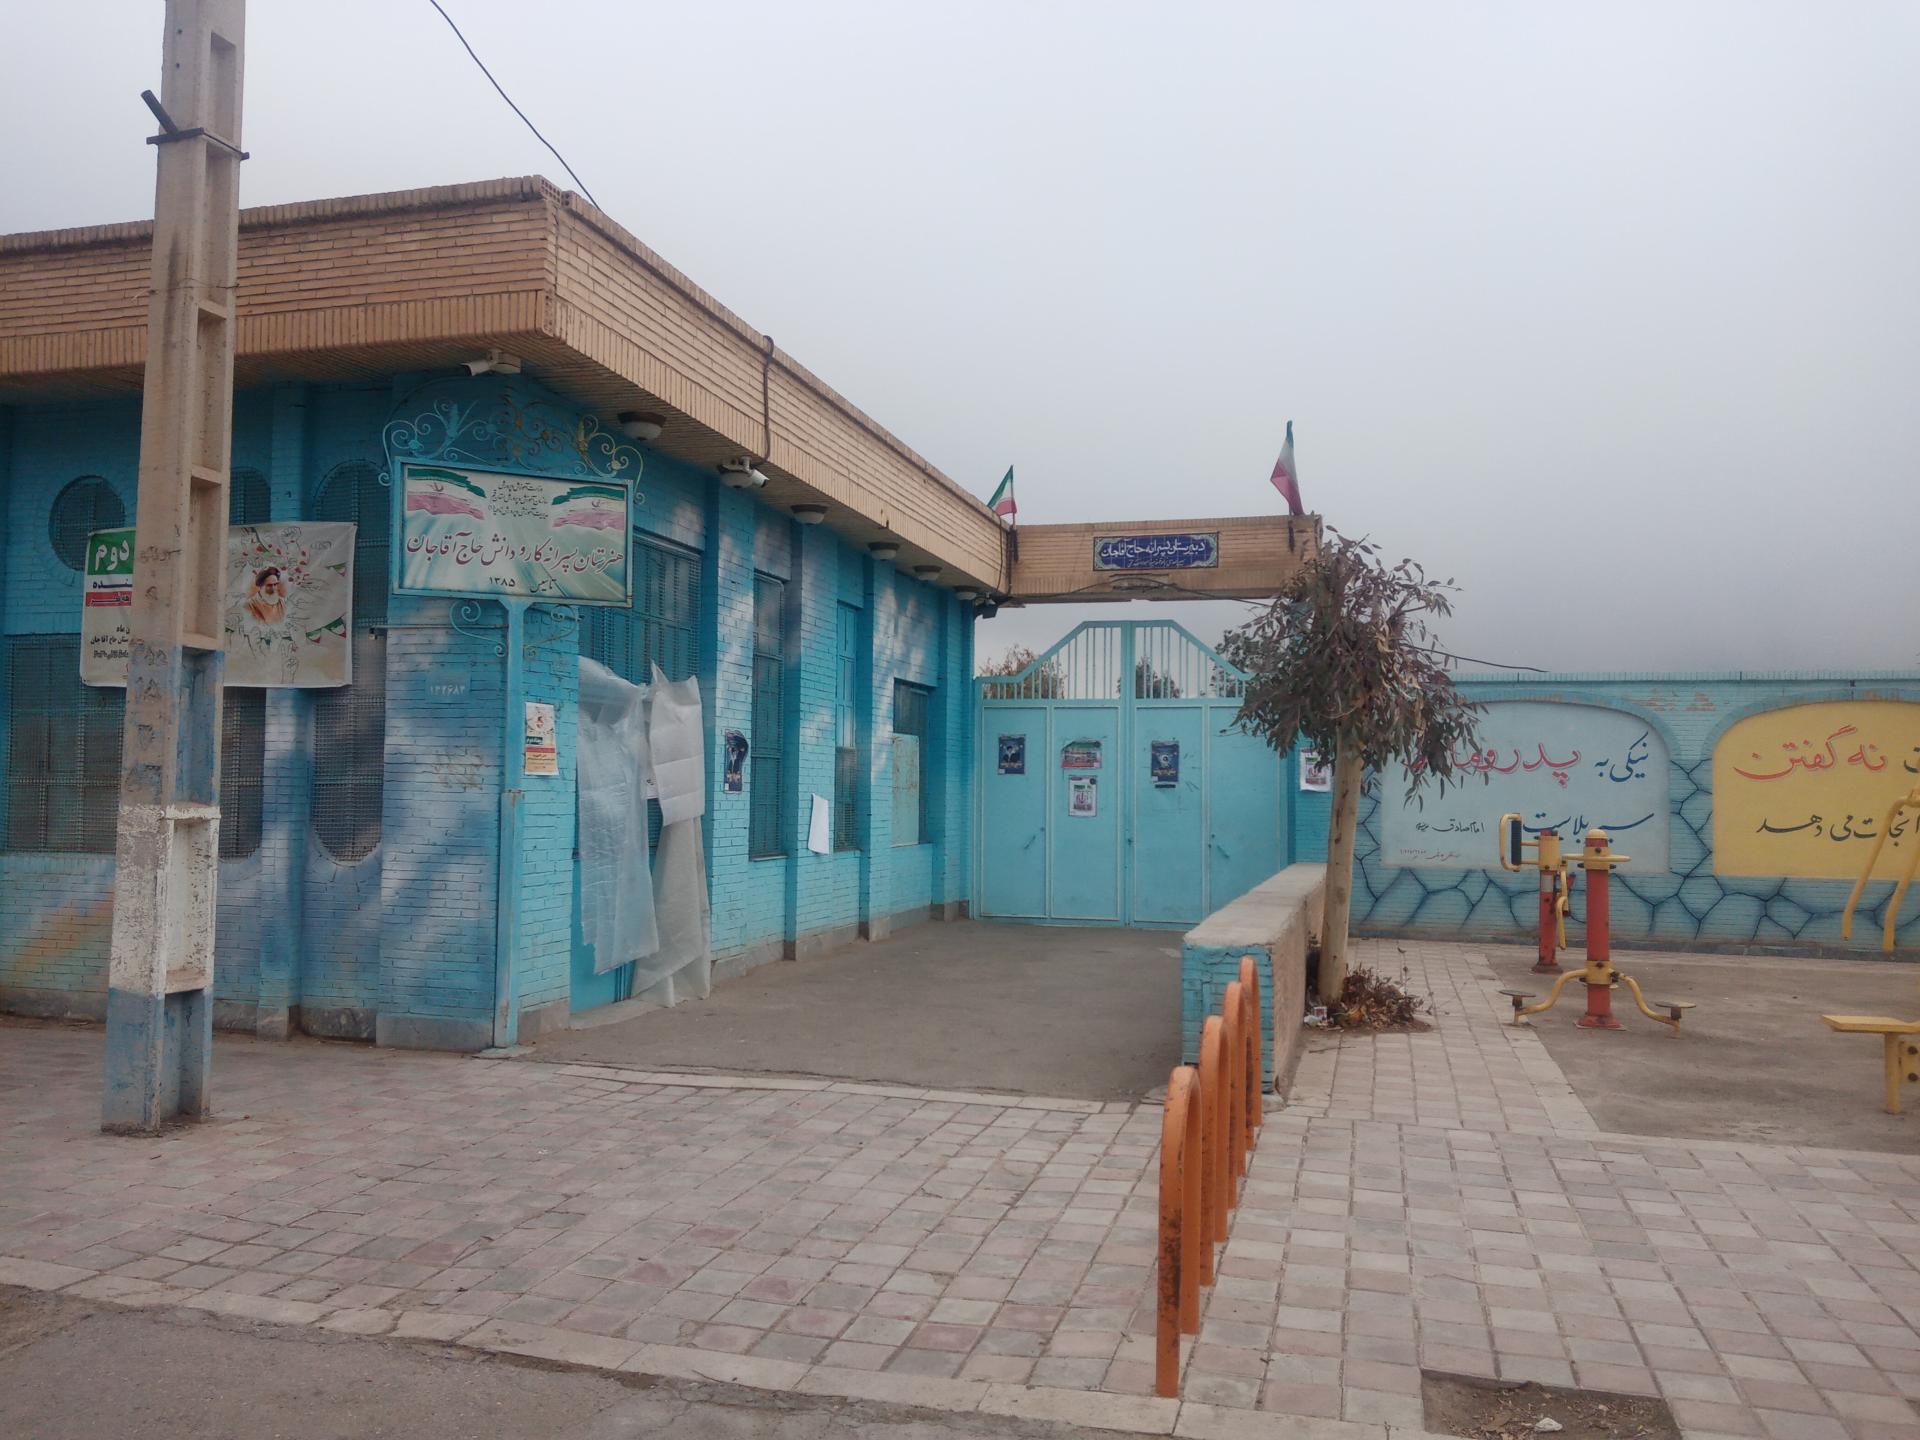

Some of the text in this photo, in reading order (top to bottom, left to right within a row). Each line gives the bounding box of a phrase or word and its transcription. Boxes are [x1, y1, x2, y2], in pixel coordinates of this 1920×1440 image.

[95, 538, 130, 571] دوم
[456, 538, 483, 565] حاج
[480, 532, 515, 566] دانش
[525, 537, 551, 562] کار
[543, 546, 578, 573] پسرانه
[573, 546, 624, 573] هنرستان
[1127, 540, 1147, 557] حاج
[1146, 539, 1171, 557] پسرانه
[1167, 538, 1206, 555] دبیرستان
[488, 576, 516, 587] ۱۳۸۵
[1493, 742, 1582, 789] پدر
[1608, 731, 1650, 783] نیکی
[1732, 724, 1858, 781] گفتن
[1846, 743, 1888, 772] نه
[1594, 757, 1609, 778] به
[1431, 818, 1471, 832] صادق
[1756, 813, 1823, 837] دهد
[1829, 814, 1854, 841] می
